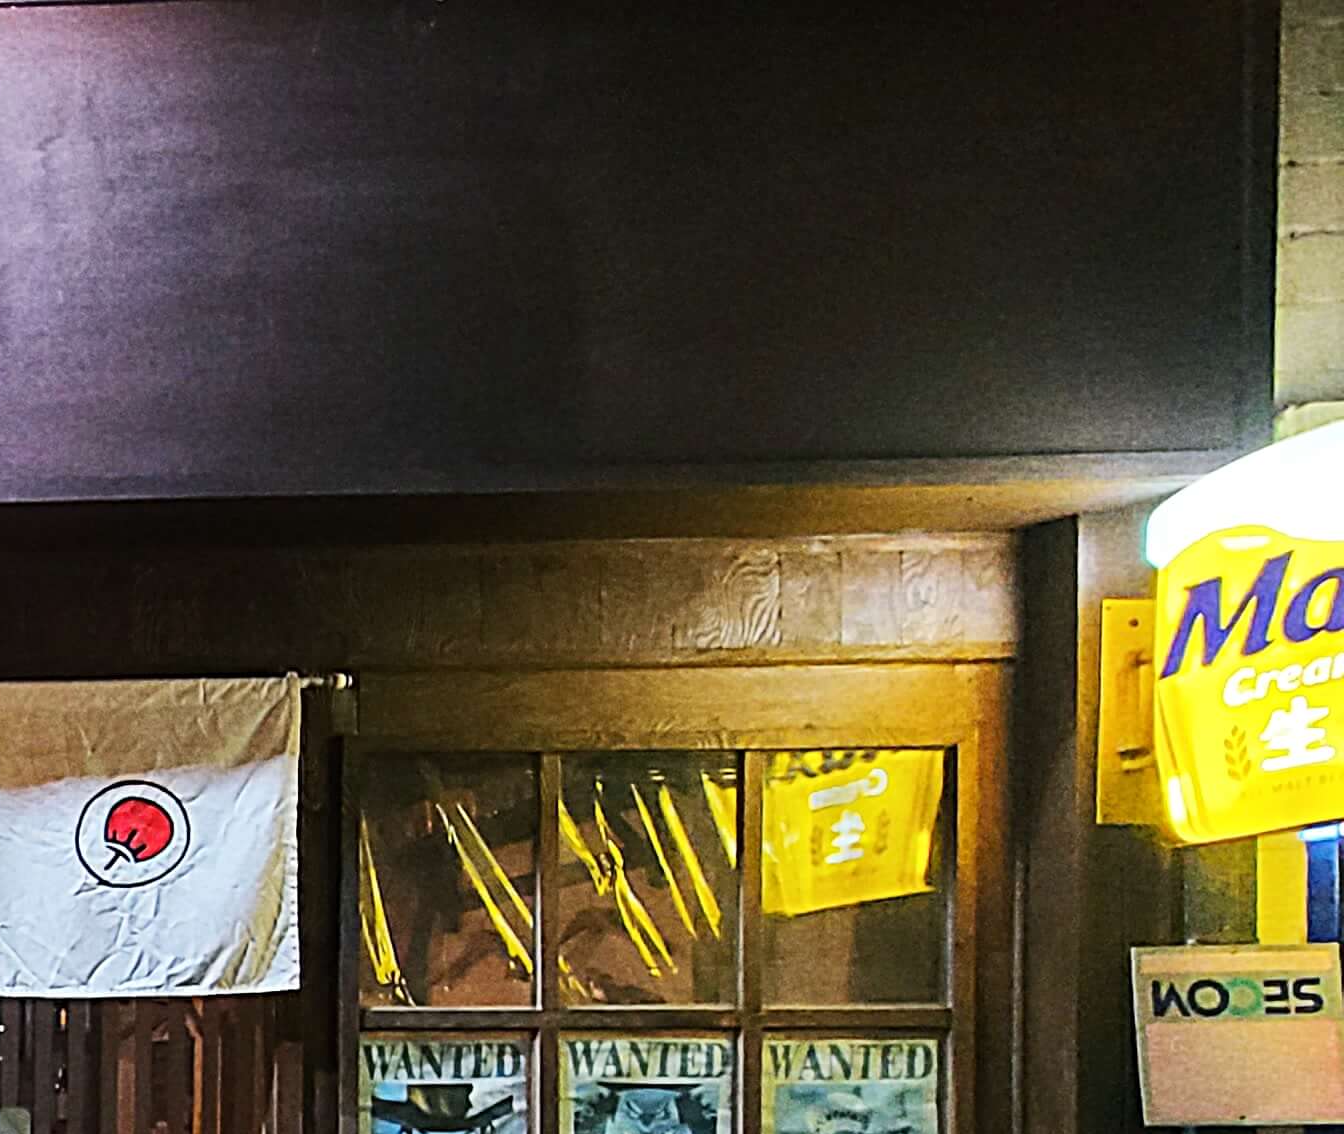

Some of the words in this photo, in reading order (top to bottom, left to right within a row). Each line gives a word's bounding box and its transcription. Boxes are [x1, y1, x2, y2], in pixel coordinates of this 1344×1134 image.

[1259, 696, 1336, 772] 生
[1151, 976, 1325, 1018] SECOM
[363, 1043, 522, 1081] WANTED
[567, 1040, 729, 1078] WANTED
[768, 1043, 934, 1080] WANTED
